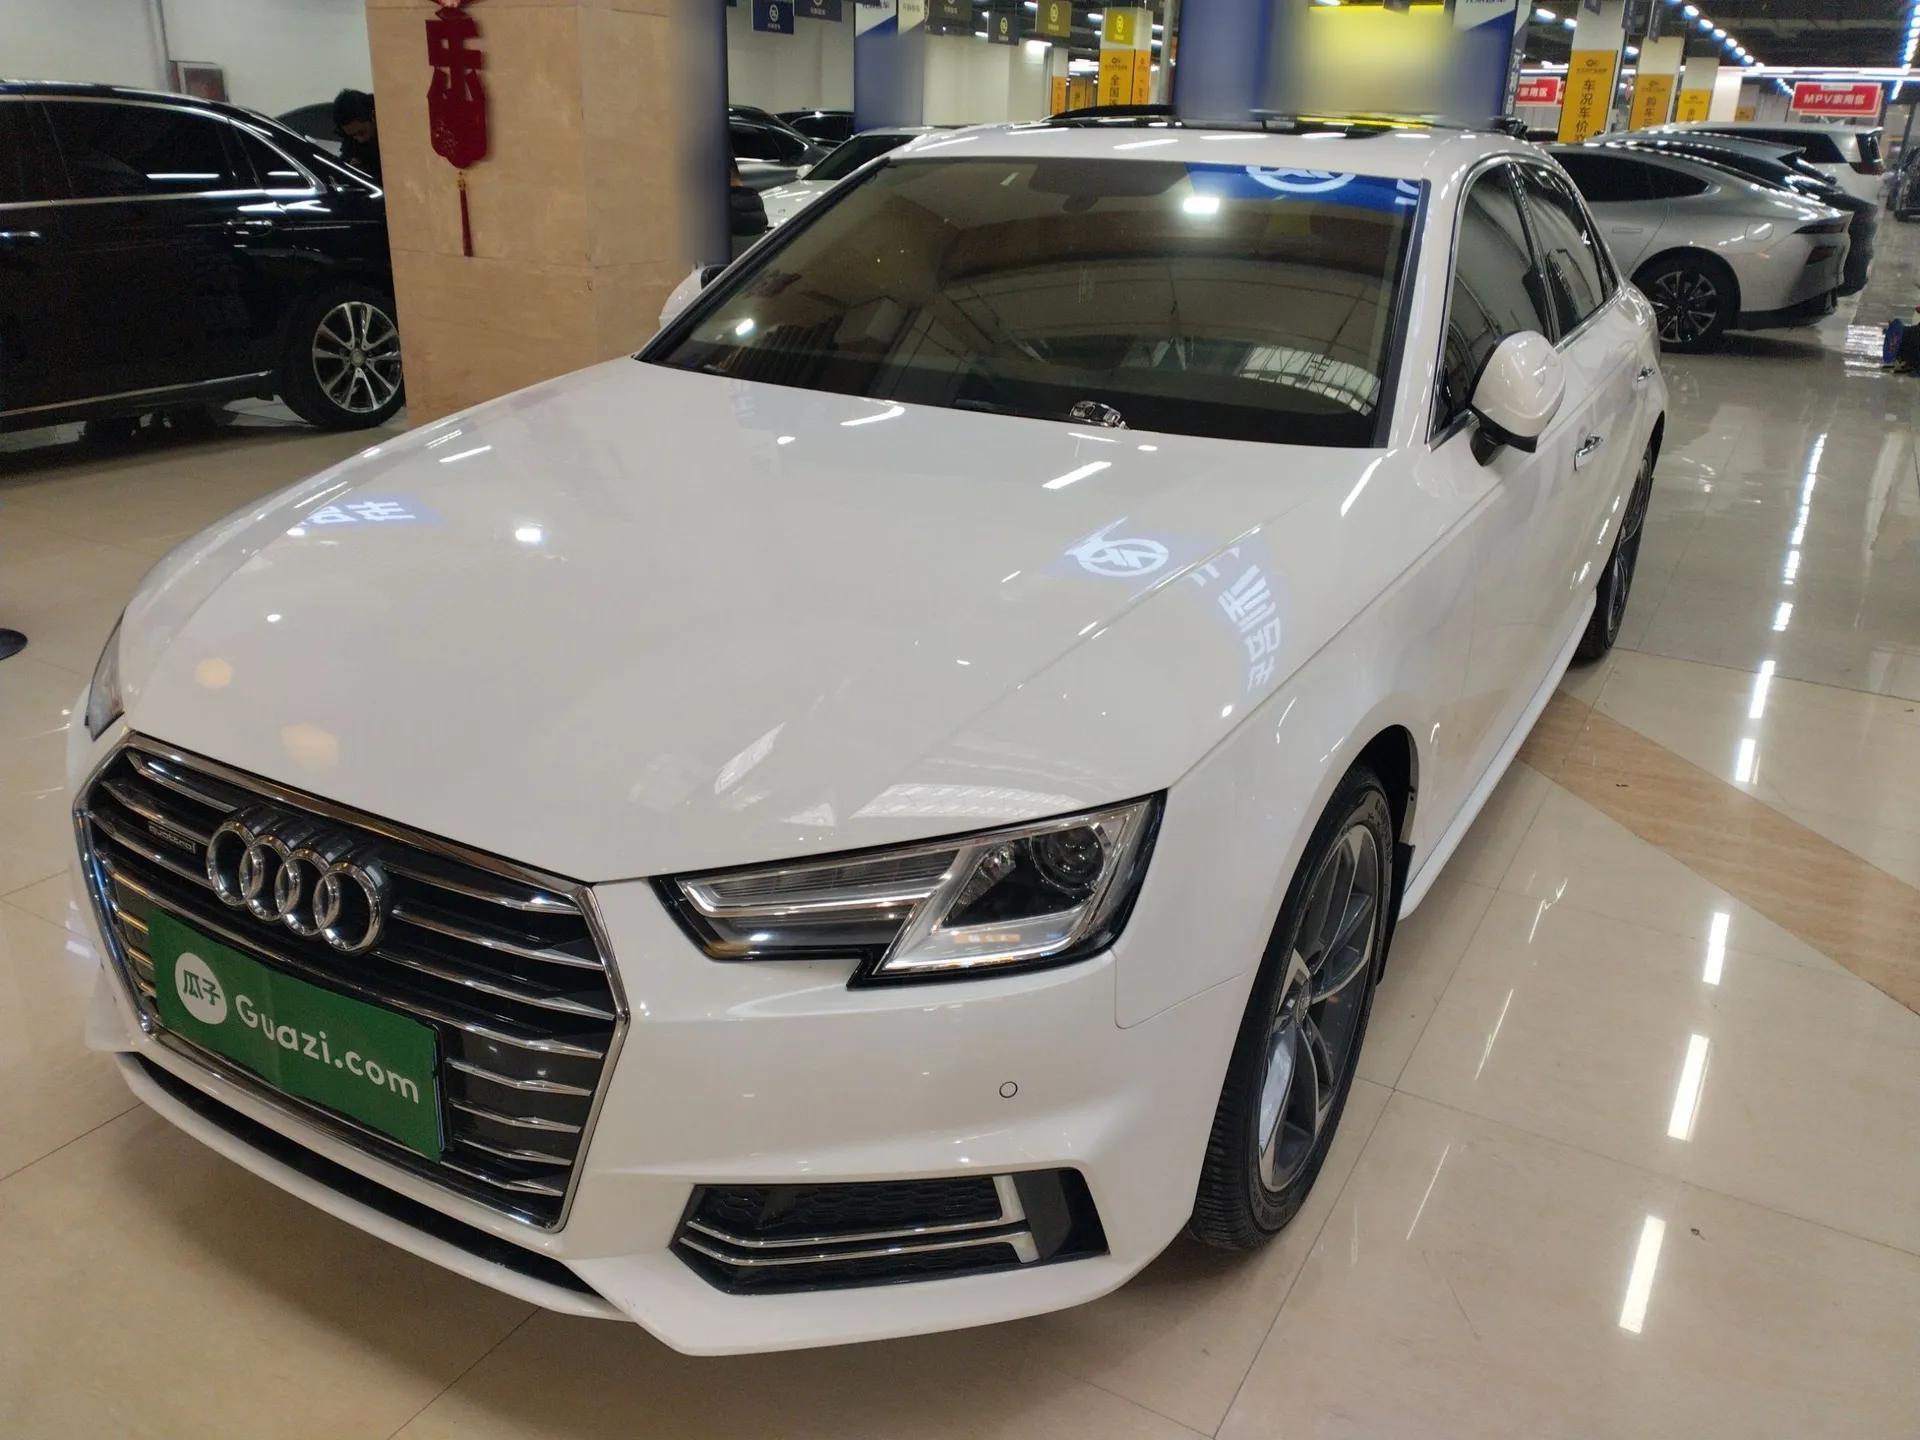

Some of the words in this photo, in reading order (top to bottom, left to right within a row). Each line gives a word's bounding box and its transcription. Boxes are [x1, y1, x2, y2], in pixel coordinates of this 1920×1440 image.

[1803, 93, 1865, 105] MPV家用区
[183, 969, 220, 1006] 瓜子
[235, 994, 420, 1104] Guazi.com
